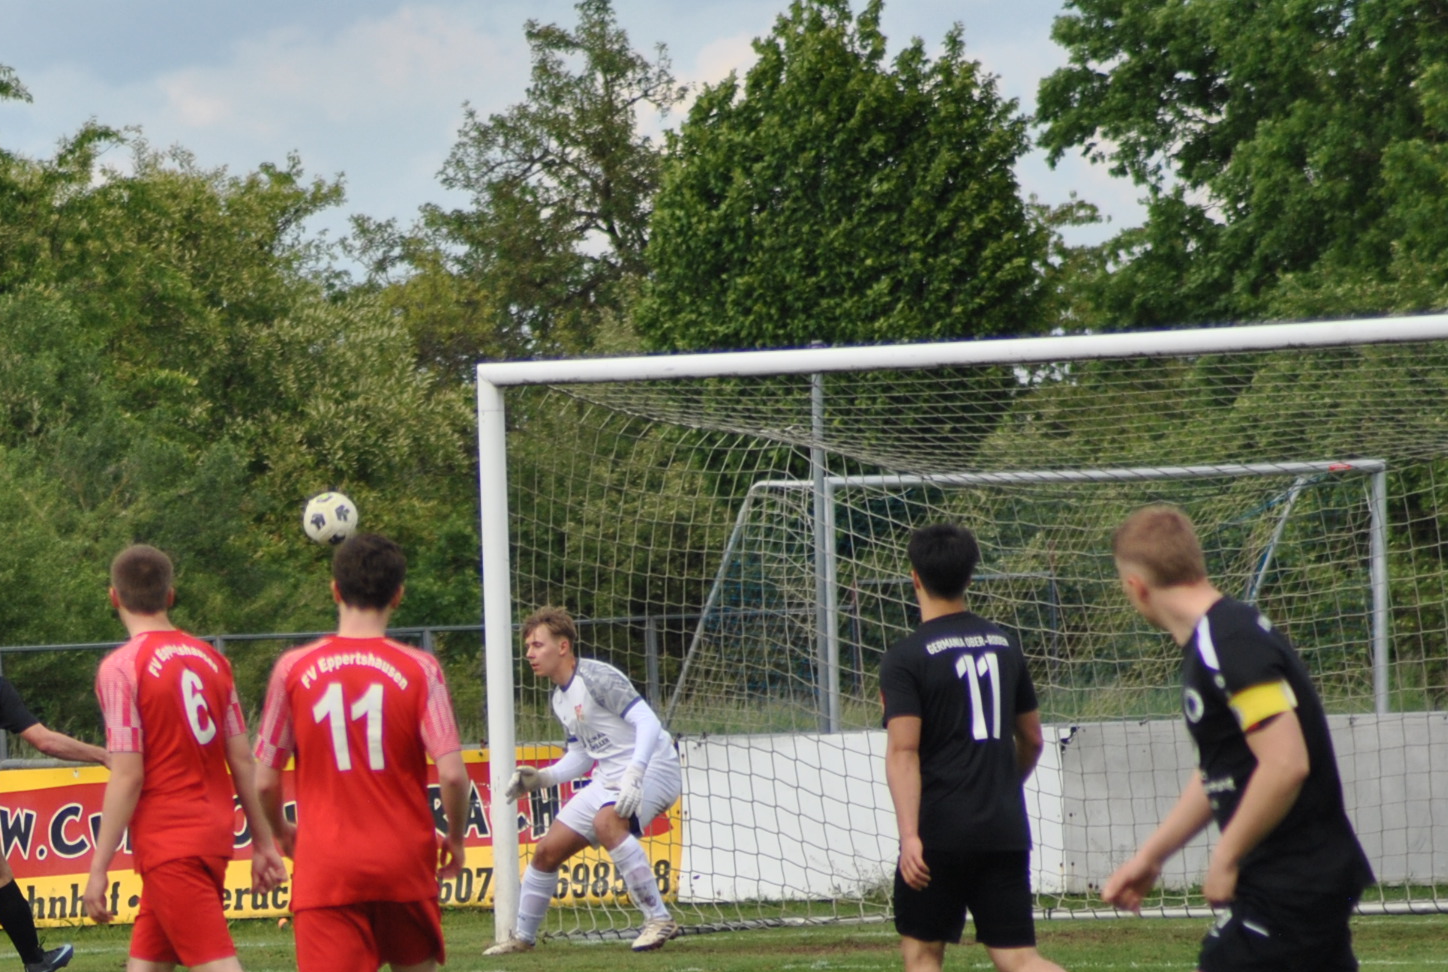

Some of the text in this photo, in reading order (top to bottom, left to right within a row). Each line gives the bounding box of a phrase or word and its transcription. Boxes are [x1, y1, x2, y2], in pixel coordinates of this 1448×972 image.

[181, 668, 217, 745] 6
[301, 652, 409, 690] FV Eppertshausen
[955, 652, 1001, 741] 11
[312, 682, 386, 772] 11
